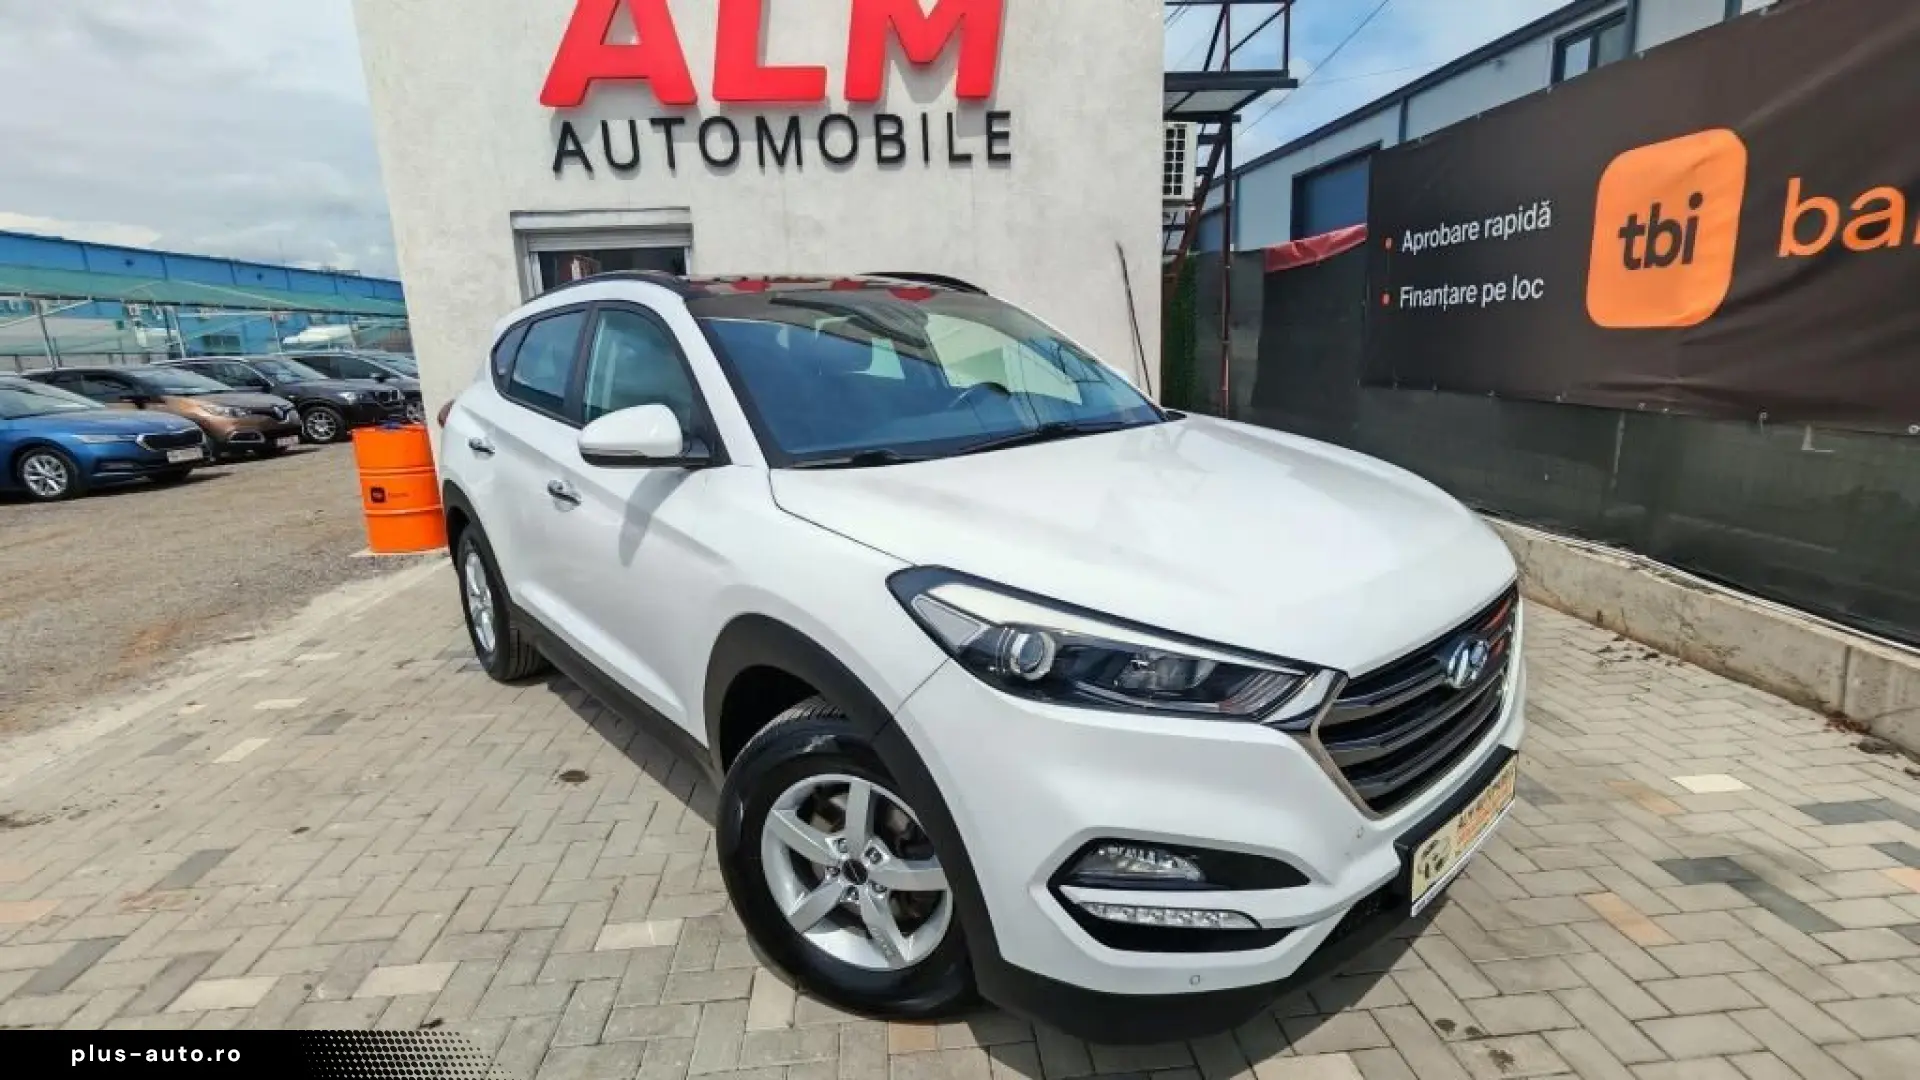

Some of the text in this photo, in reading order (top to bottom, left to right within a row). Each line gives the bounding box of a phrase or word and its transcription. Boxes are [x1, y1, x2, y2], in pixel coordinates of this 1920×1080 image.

[541, 0, 1001, 106] ALM
[553, 111, 1011, 173] AUTOMOBILE
[1402, 199, 1551, 255] Aprobare rapidă
[1617, 177, 1920, 271] tbi ba
[1400, 273, 1544, 311] Finanțare pe loc
